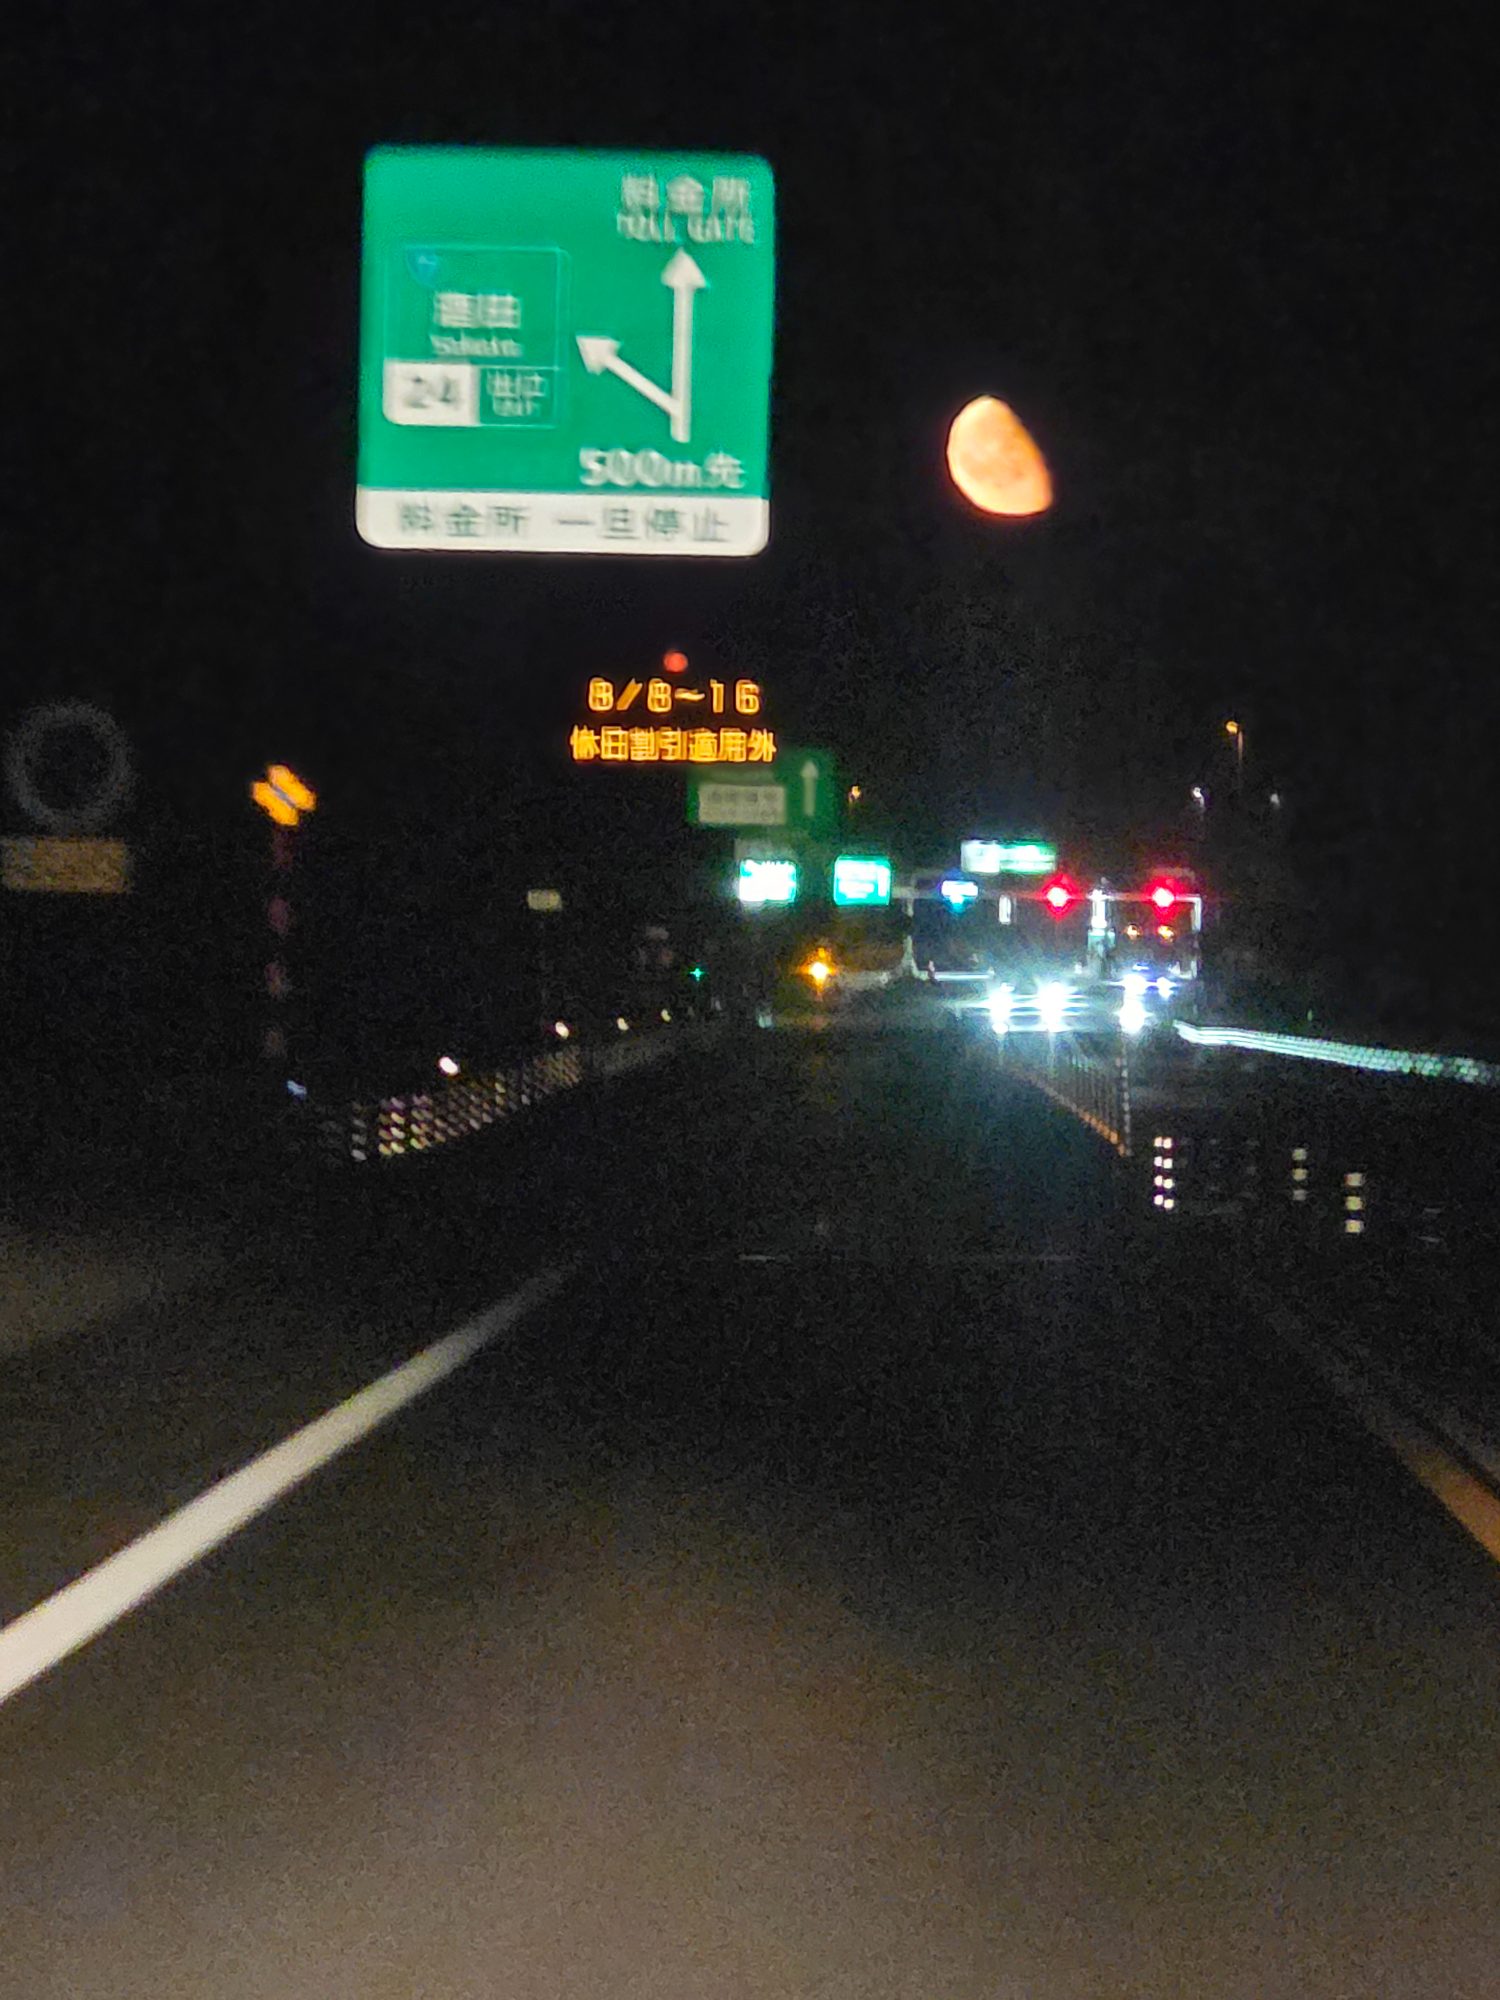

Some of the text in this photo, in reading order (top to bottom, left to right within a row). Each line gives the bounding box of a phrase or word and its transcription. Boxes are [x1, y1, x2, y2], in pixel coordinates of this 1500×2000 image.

[579, 447, 746, 489] 500m先
[399, 503, 731, 543] 料金所 一旦停止
[570, 725, 777, 763] 休日割引適用外
